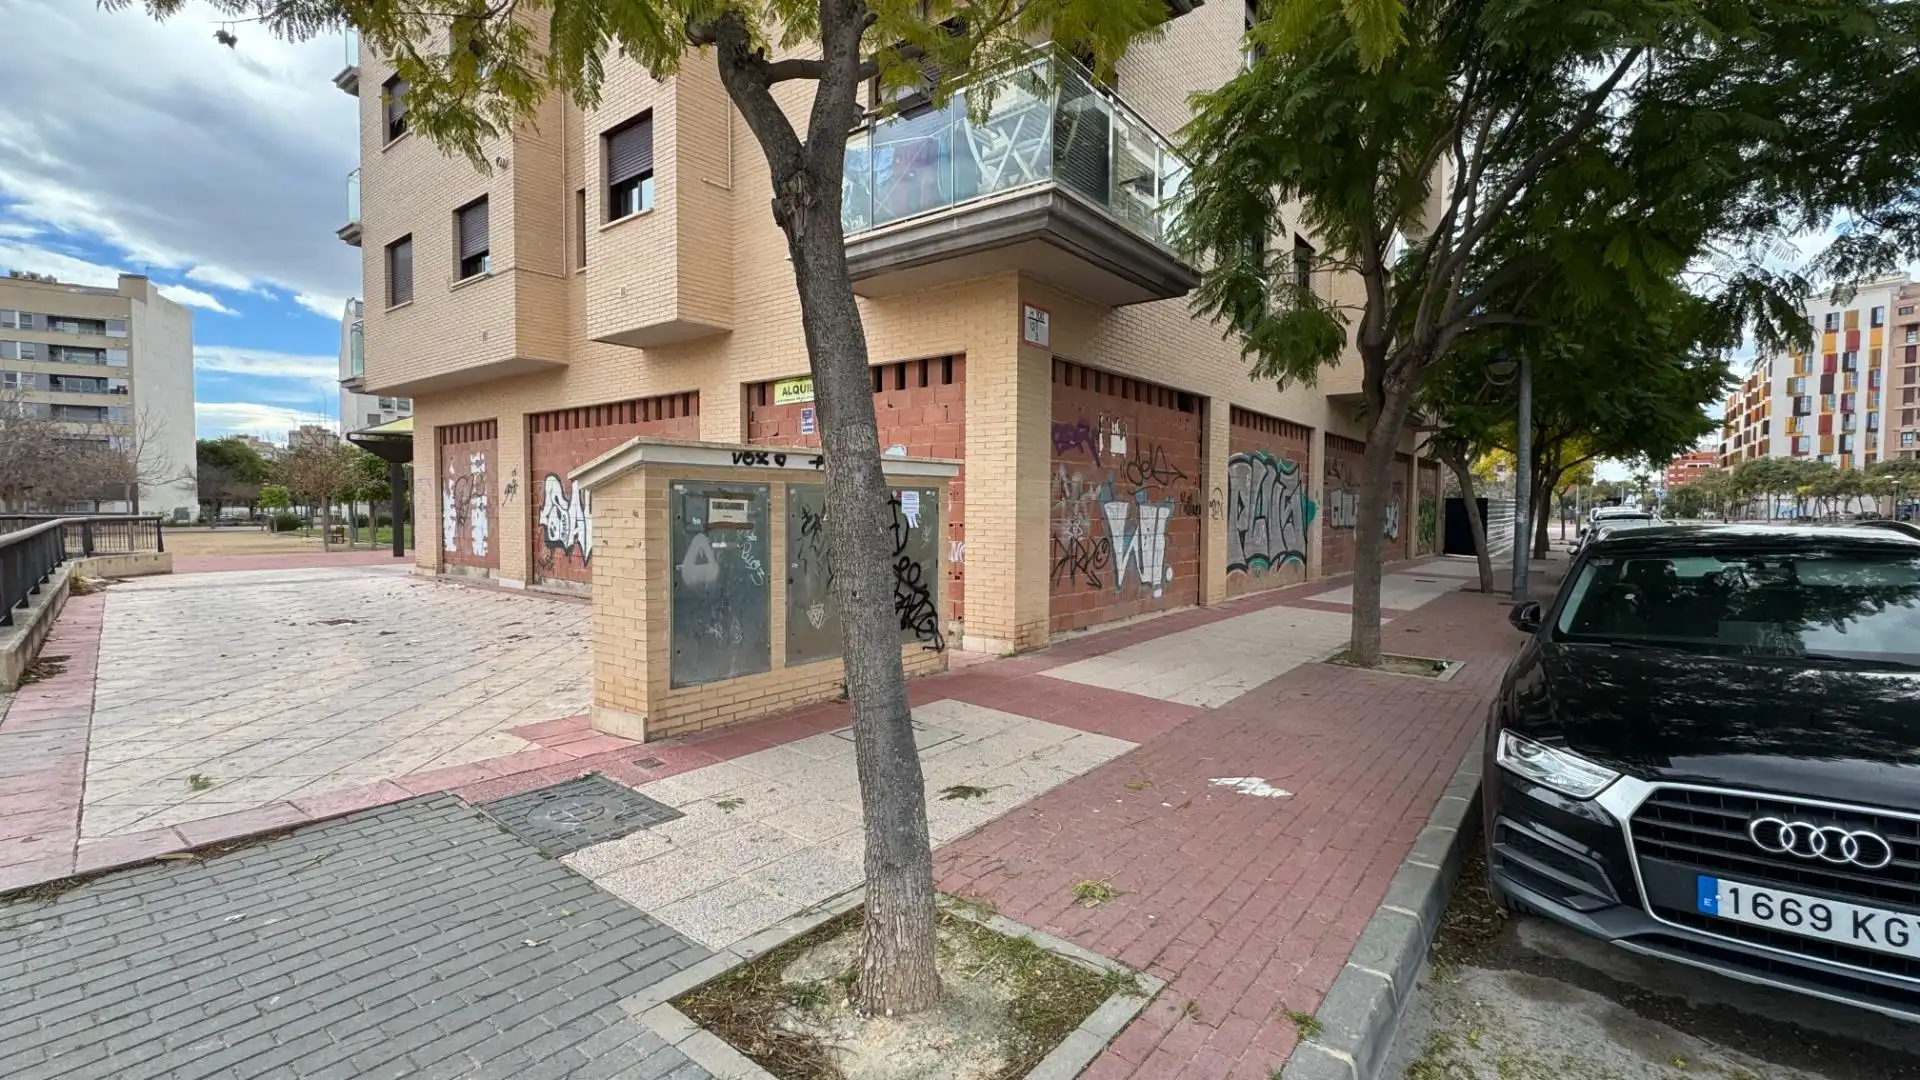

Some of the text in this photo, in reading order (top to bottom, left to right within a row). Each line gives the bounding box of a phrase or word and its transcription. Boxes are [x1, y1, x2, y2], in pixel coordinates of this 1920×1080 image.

[732, 451, 769, 466] VOX
[1703, 897, 1712, 907] E
[1728, 887, 1920, 948] 1669 KG
